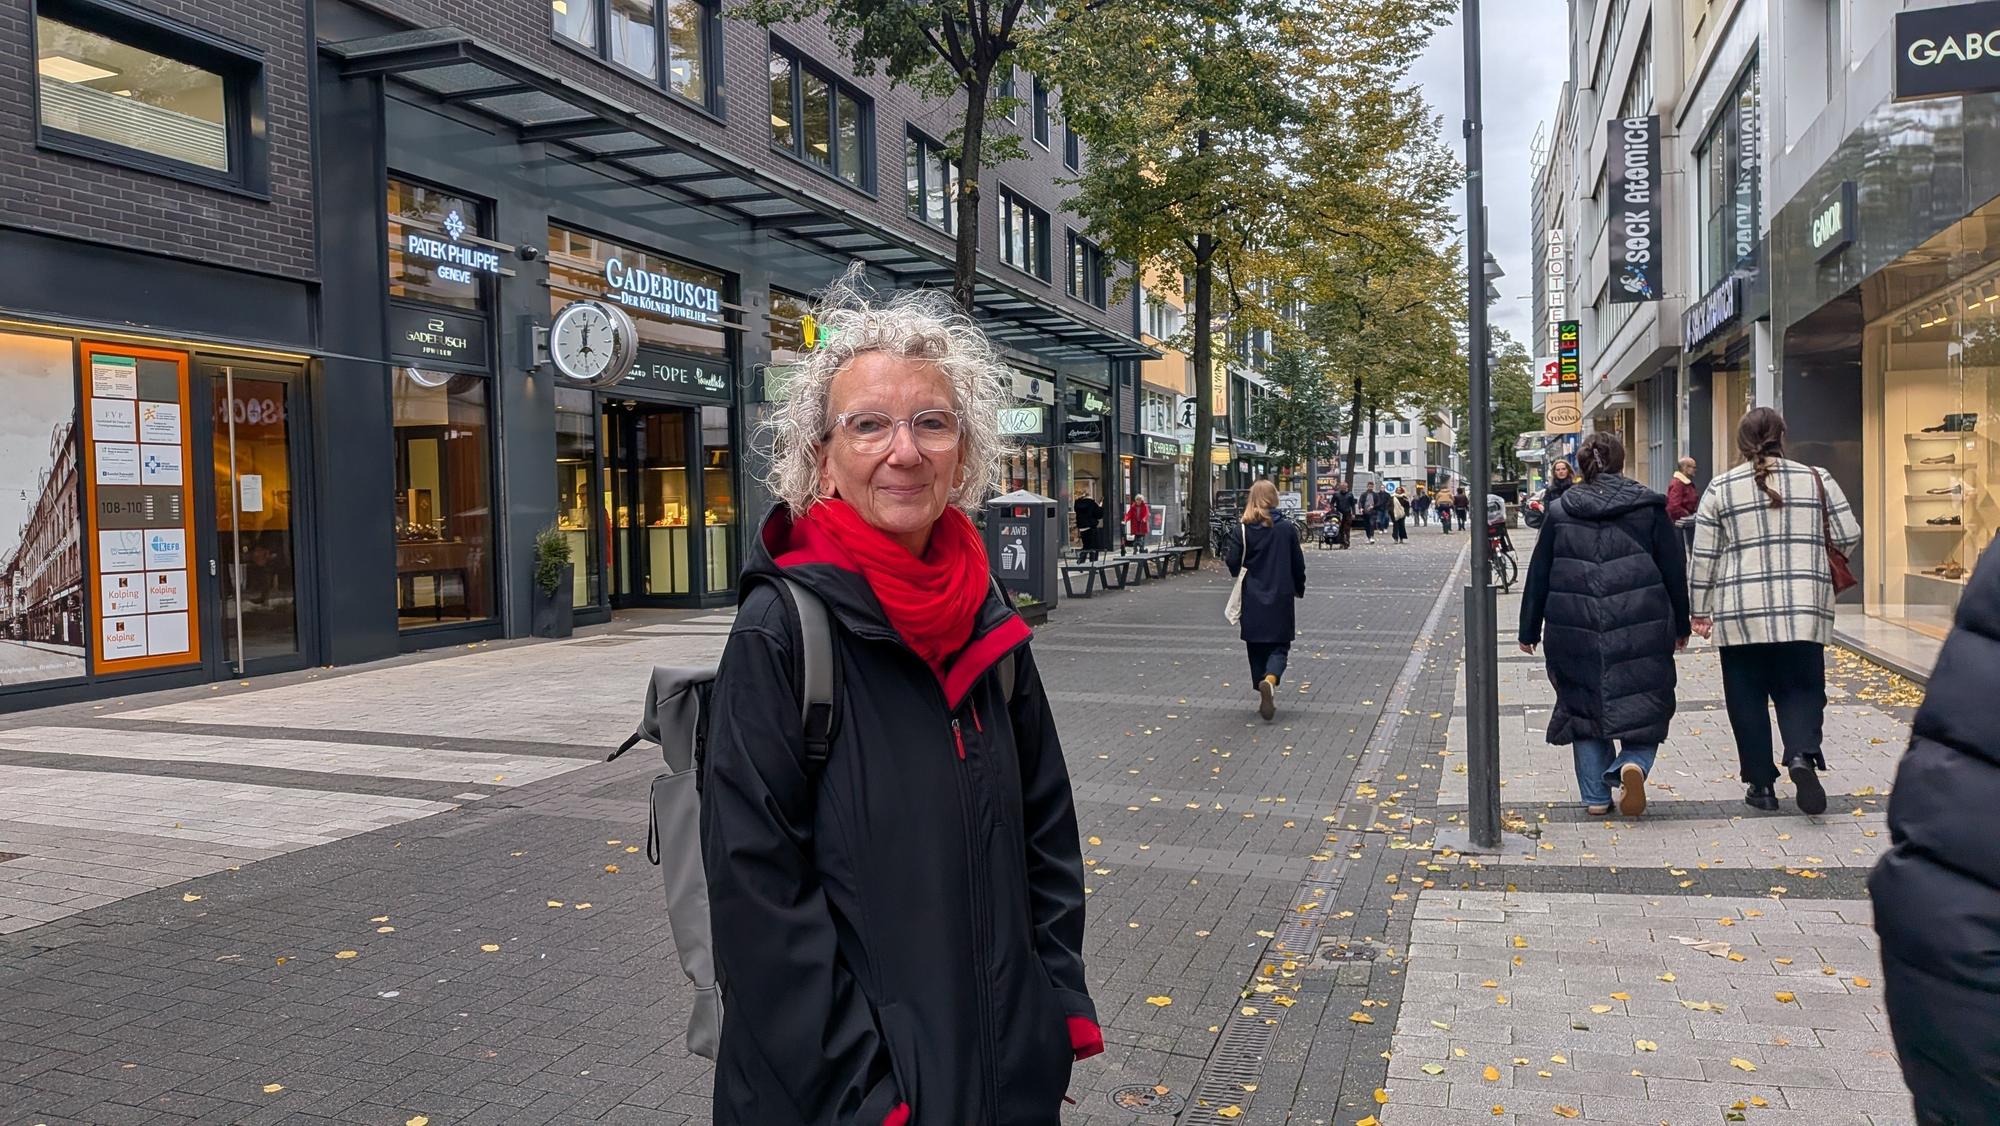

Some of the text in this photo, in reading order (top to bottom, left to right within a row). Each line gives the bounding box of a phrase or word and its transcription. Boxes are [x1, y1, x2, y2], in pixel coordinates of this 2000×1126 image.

[1625, 209, 1650, 263] SOCK
[408, 235, 499, 273] PATEK PHILIPPE
[437, 266, 471, 284] GENEVE
[606, 258, 719, 312] GADEBUSCH
[621, 291, 707, 323] DER KÖLNER JUWELIER
[1562, 324, 1577, 381] BUTLERS
[652, 364, 689, 384] FOPE
[101, 502, 142, 513] 108-110
[1010, 526, 1028, 536] AWB
[108, 590, 139, 599] Kolping
[150, 585, 177, 595] Kolping
[106, 632, 135, 642] Kolping
